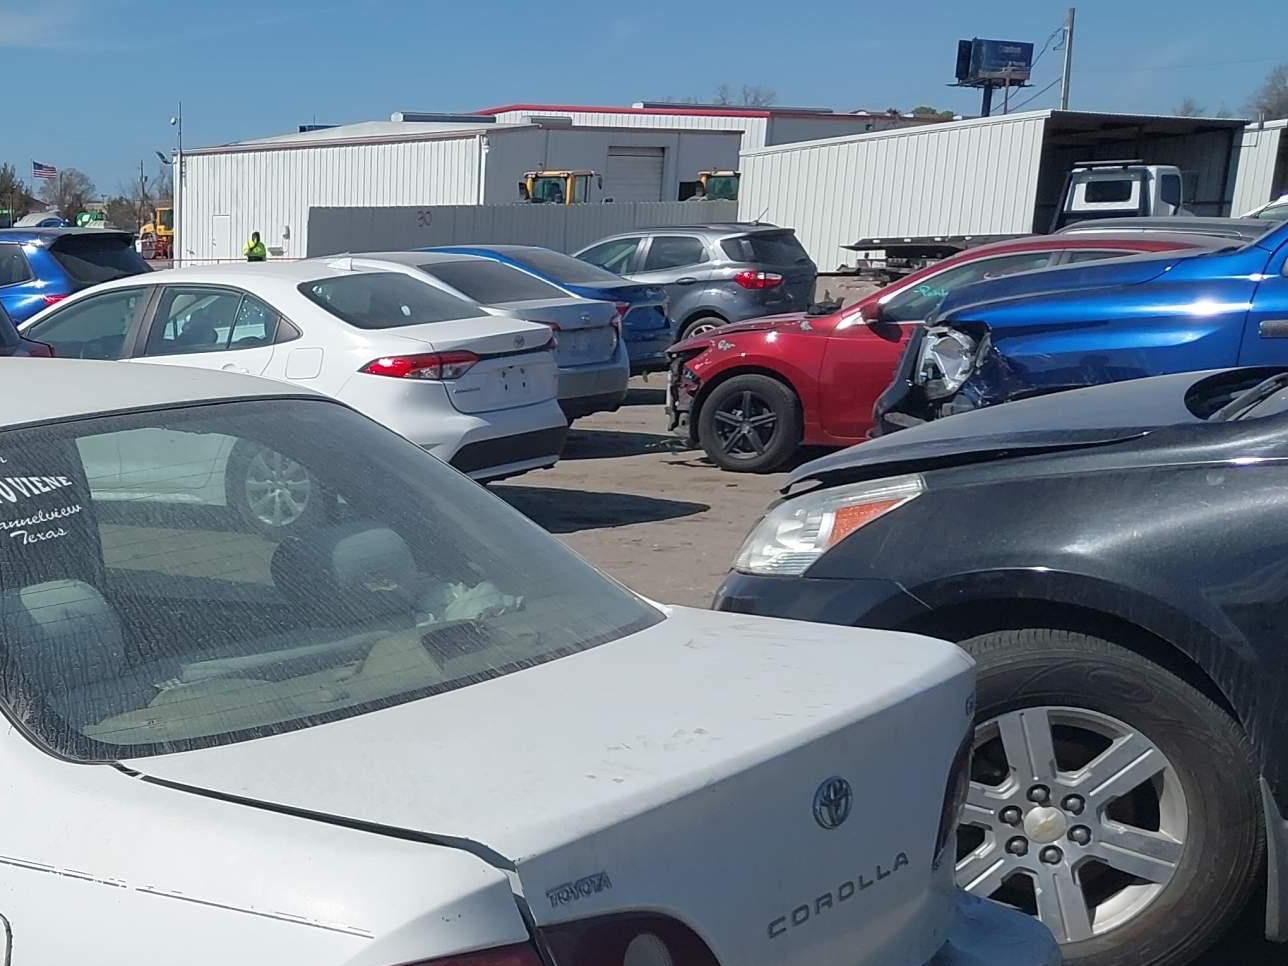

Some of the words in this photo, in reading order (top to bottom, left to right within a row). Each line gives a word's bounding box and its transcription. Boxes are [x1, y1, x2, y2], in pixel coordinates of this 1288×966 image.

[9, 476, 73, 498] VIENE
[9, 527, 68, 545] Texas
[545, 871, 613, 908] TOYOTA
[767, 852, 910, 939] COROLLA
